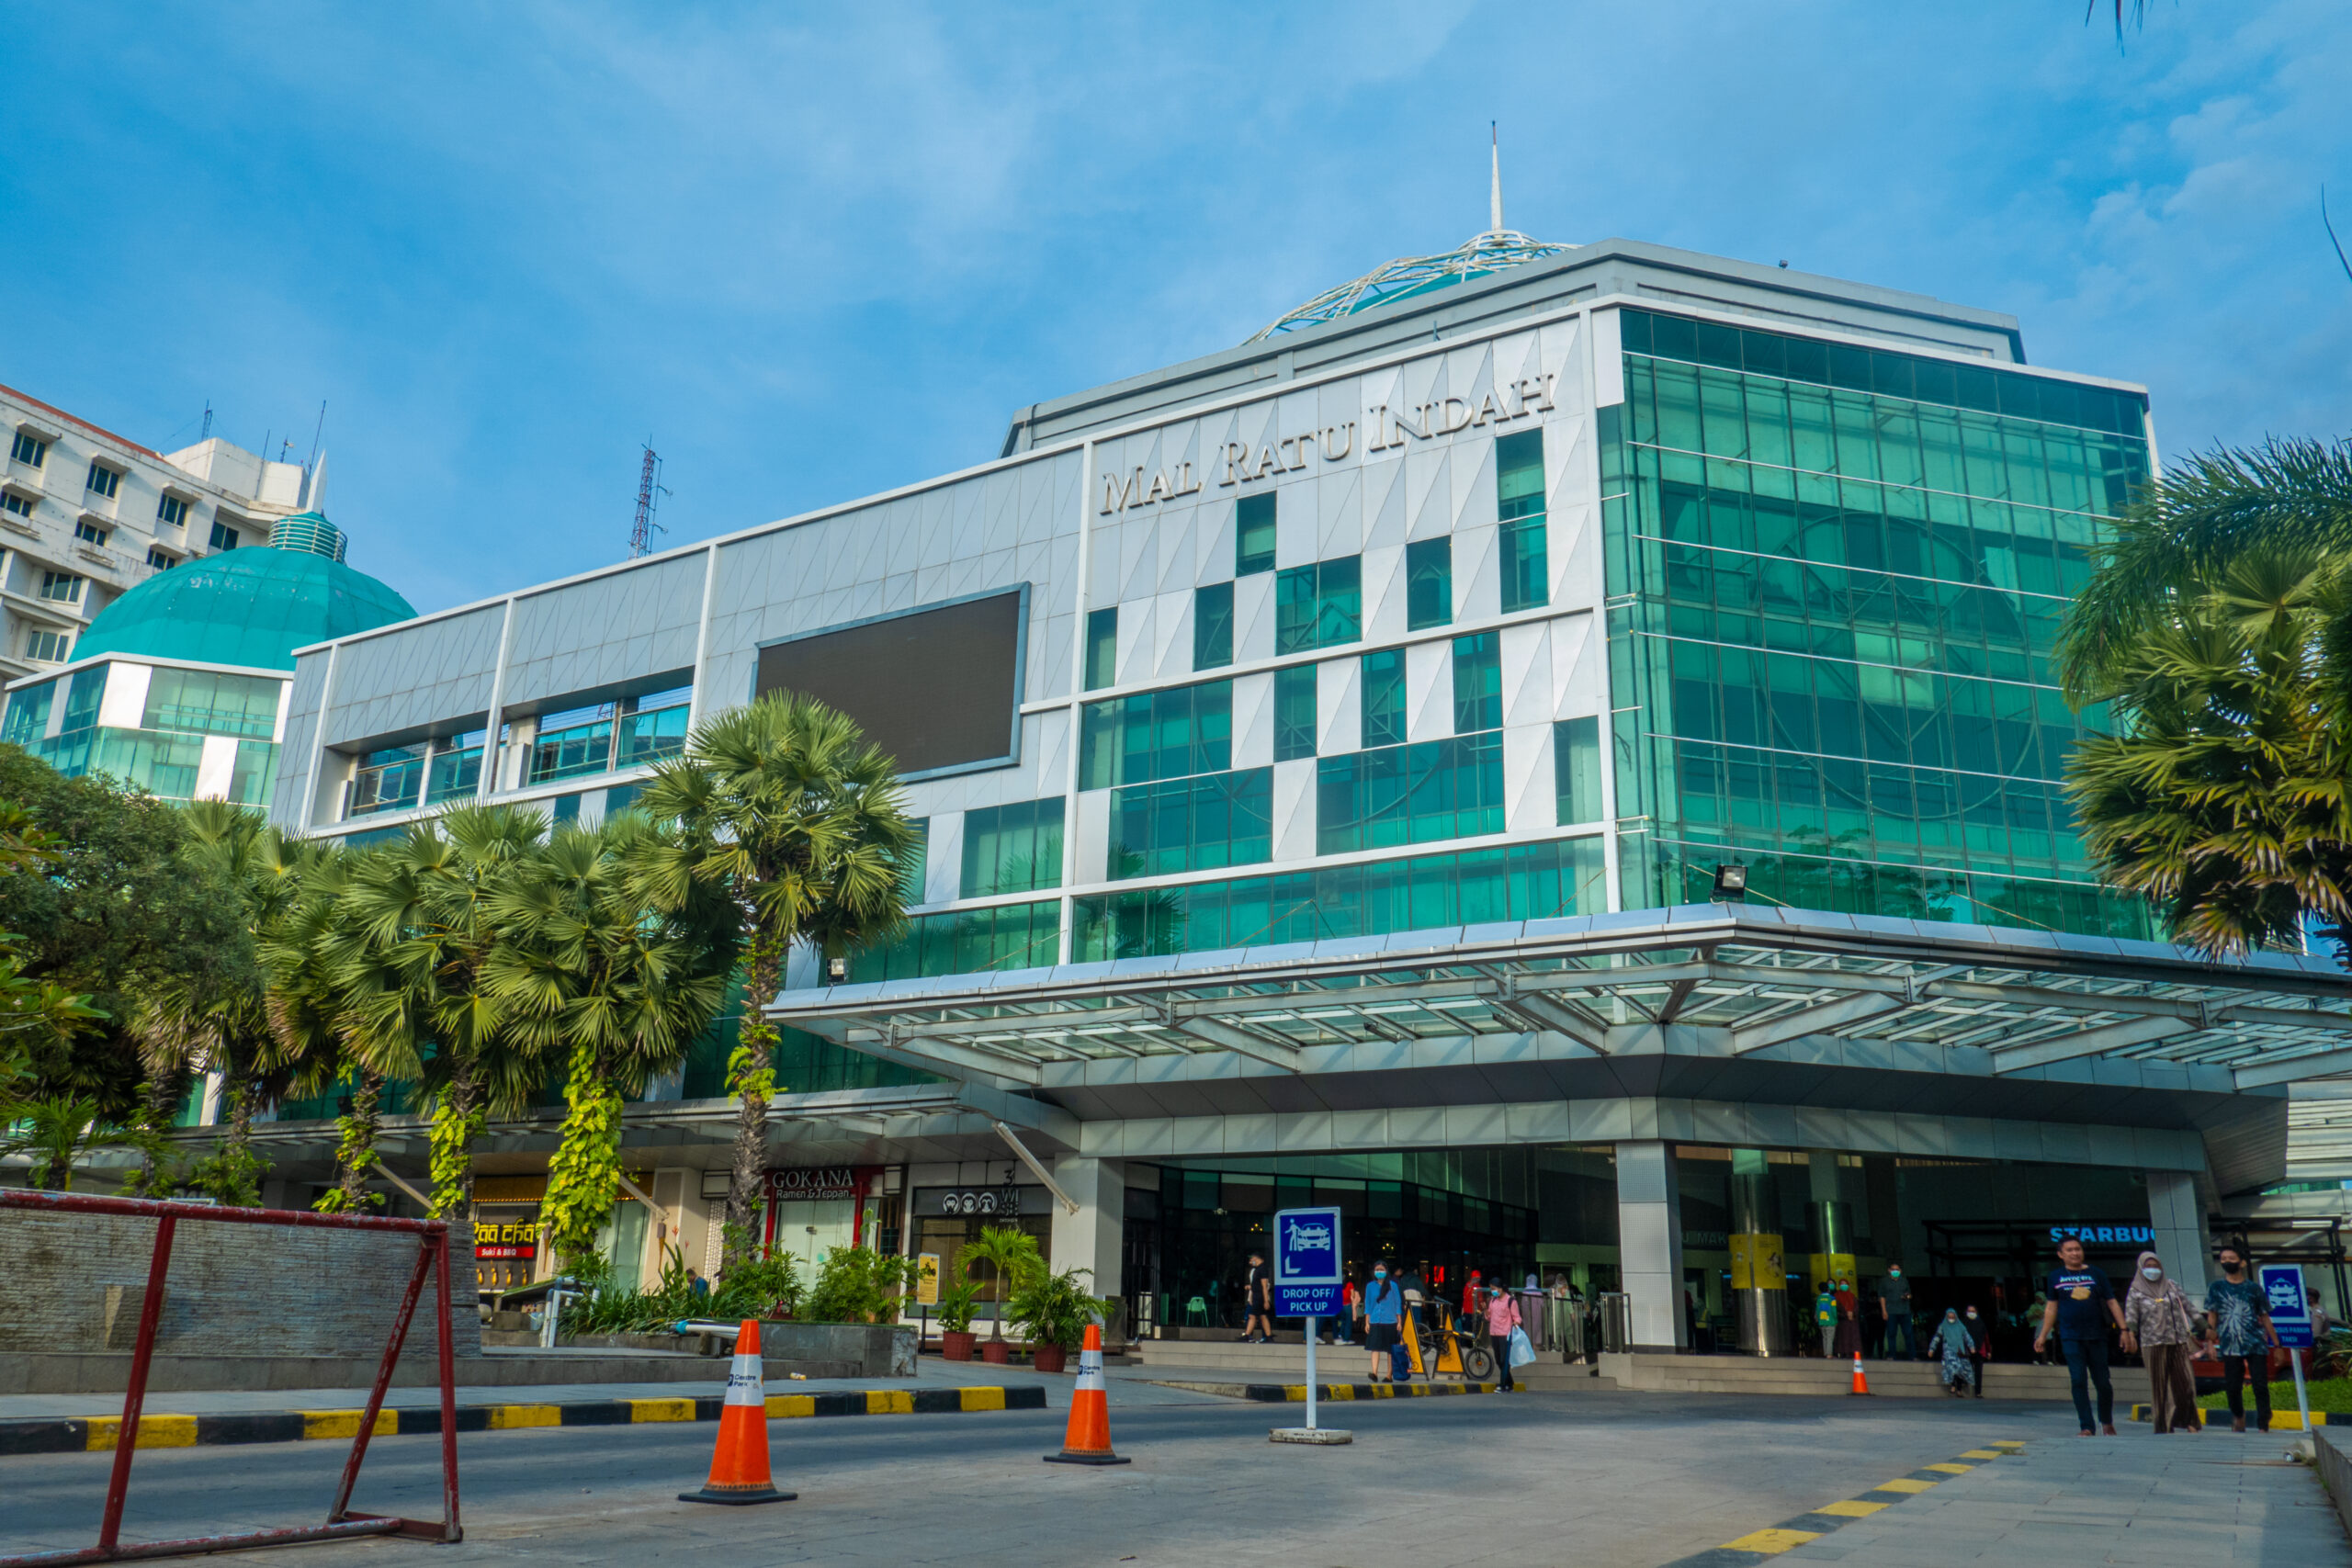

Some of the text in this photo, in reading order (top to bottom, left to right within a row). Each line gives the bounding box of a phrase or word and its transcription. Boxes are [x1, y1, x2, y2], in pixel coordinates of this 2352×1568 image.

[1100, 374, 1555, 515] MAL RATU INDAH
[773, 1169, 854, 1189] GOKANA
[776, 1189, 806, 1199] Ramen
[817, 1188, 849, 1201] Teppan
[481, 1248, 495, 1257] Suki
[1283, 1288, 1335, 1298] DROP OFF/
[1290, 1302, 1329, 1312] PICK UP
